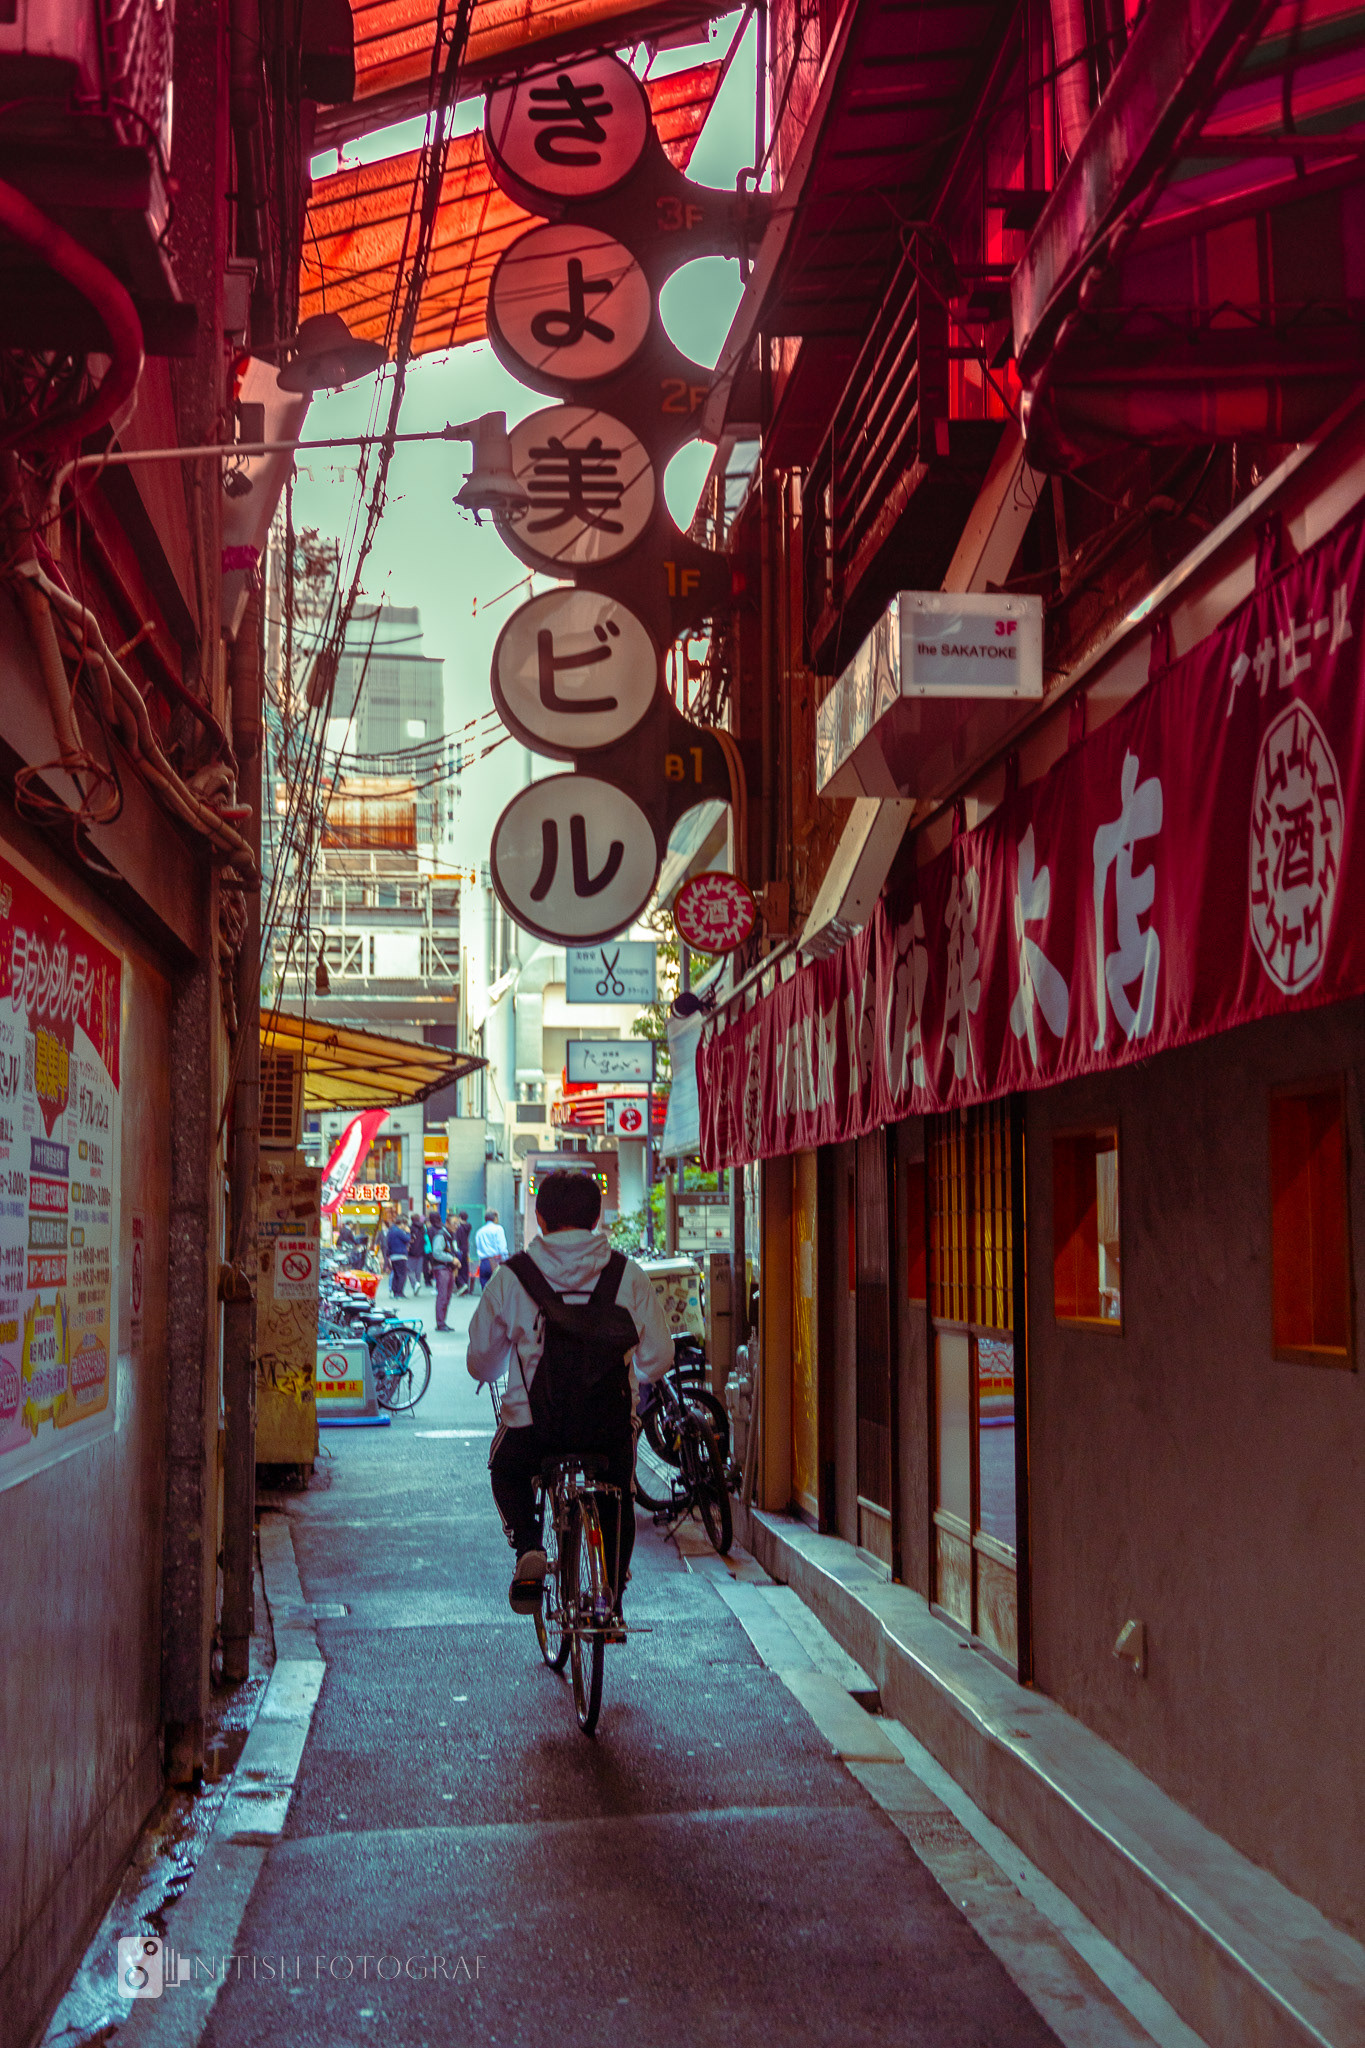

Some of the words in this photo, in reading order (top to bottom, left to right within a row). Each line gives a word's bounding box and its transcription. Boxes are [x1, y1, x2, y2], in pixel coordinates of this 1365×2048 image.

[655, 197, 704, 231] 3F
[661, 379, 708, 414] 2F
[664, 561, 700, 597] 1F
[994, 620, 1018, 636] 3F
[917, 643, 937, 656] the
[941, 643, 1018, 660] SAKATOKE
[665, 747, 703, 783] B1
[1275, 799, 1315, 893] 酒
[699, 898, 729, 924] 酒
[36, 1024, 69, 1107] 募集中
